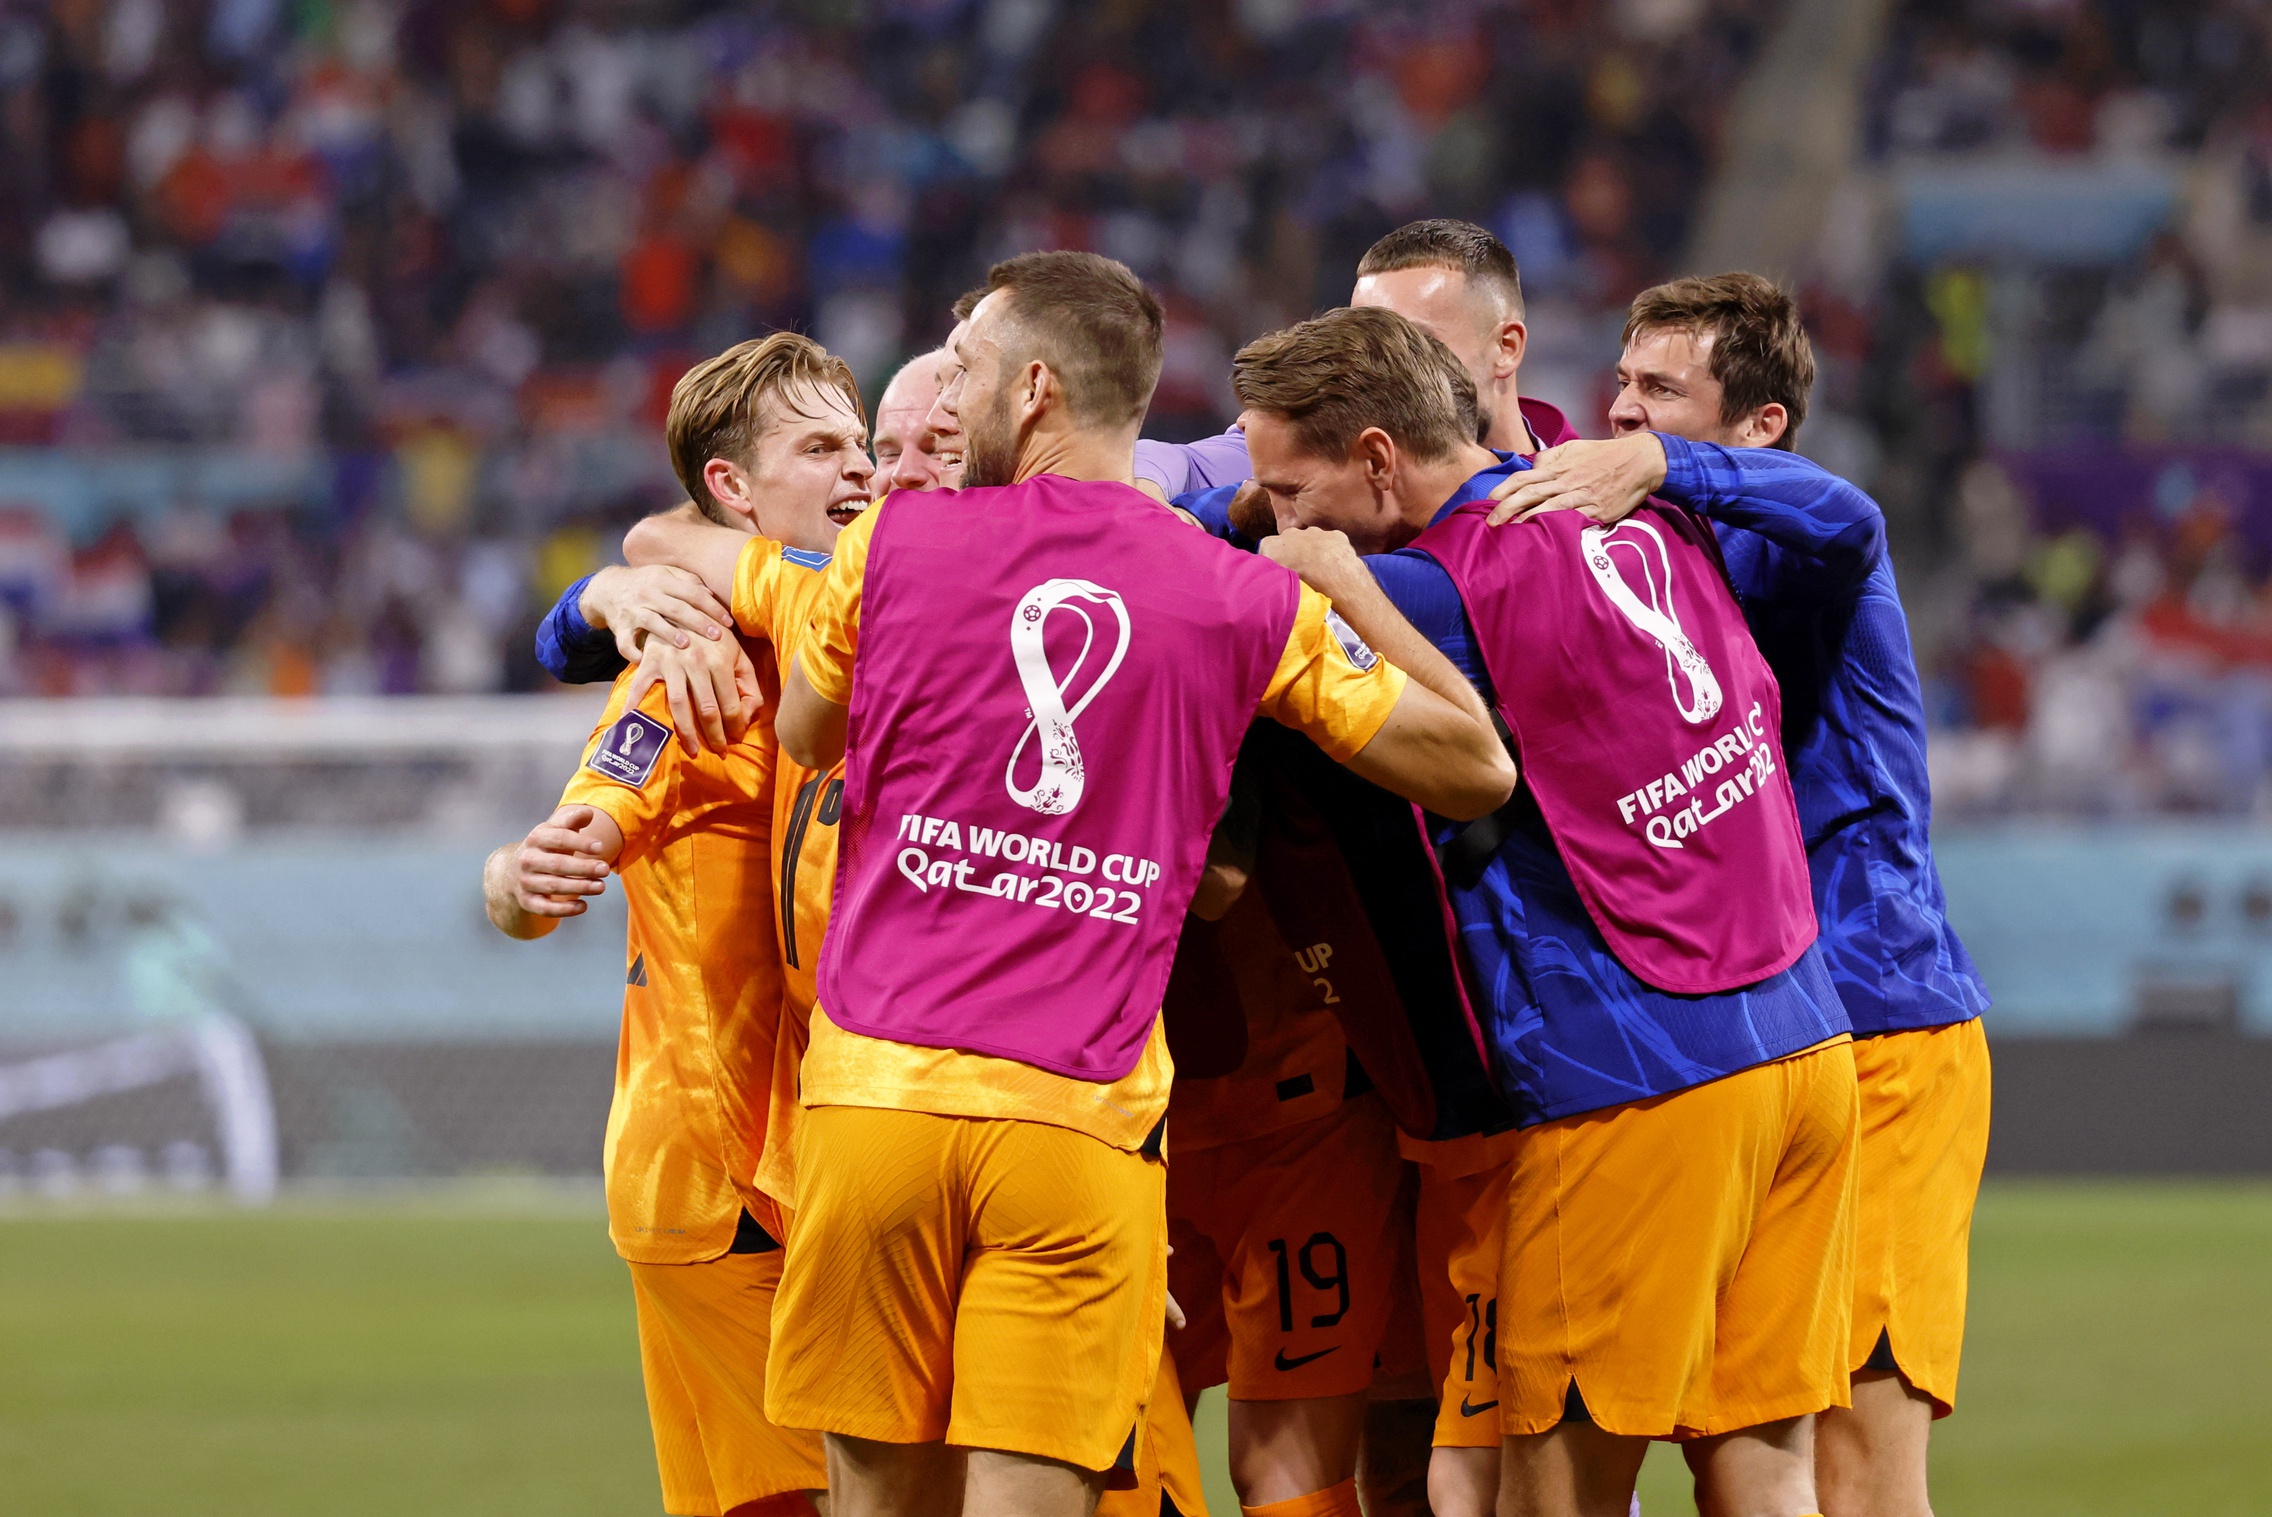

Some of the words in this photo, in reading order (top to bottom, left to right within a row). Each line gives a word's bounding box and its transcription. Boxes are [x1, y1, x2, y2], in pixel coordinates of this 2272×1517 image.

[1616, 772, 1688, 825] FIFA
[969, 825, 1097, 875] WORLD
[1101, 853, 1161, 888] CUP
[1294, 942, 1333, 974] UP
[1267, 1231, 1350, 1332] 19
